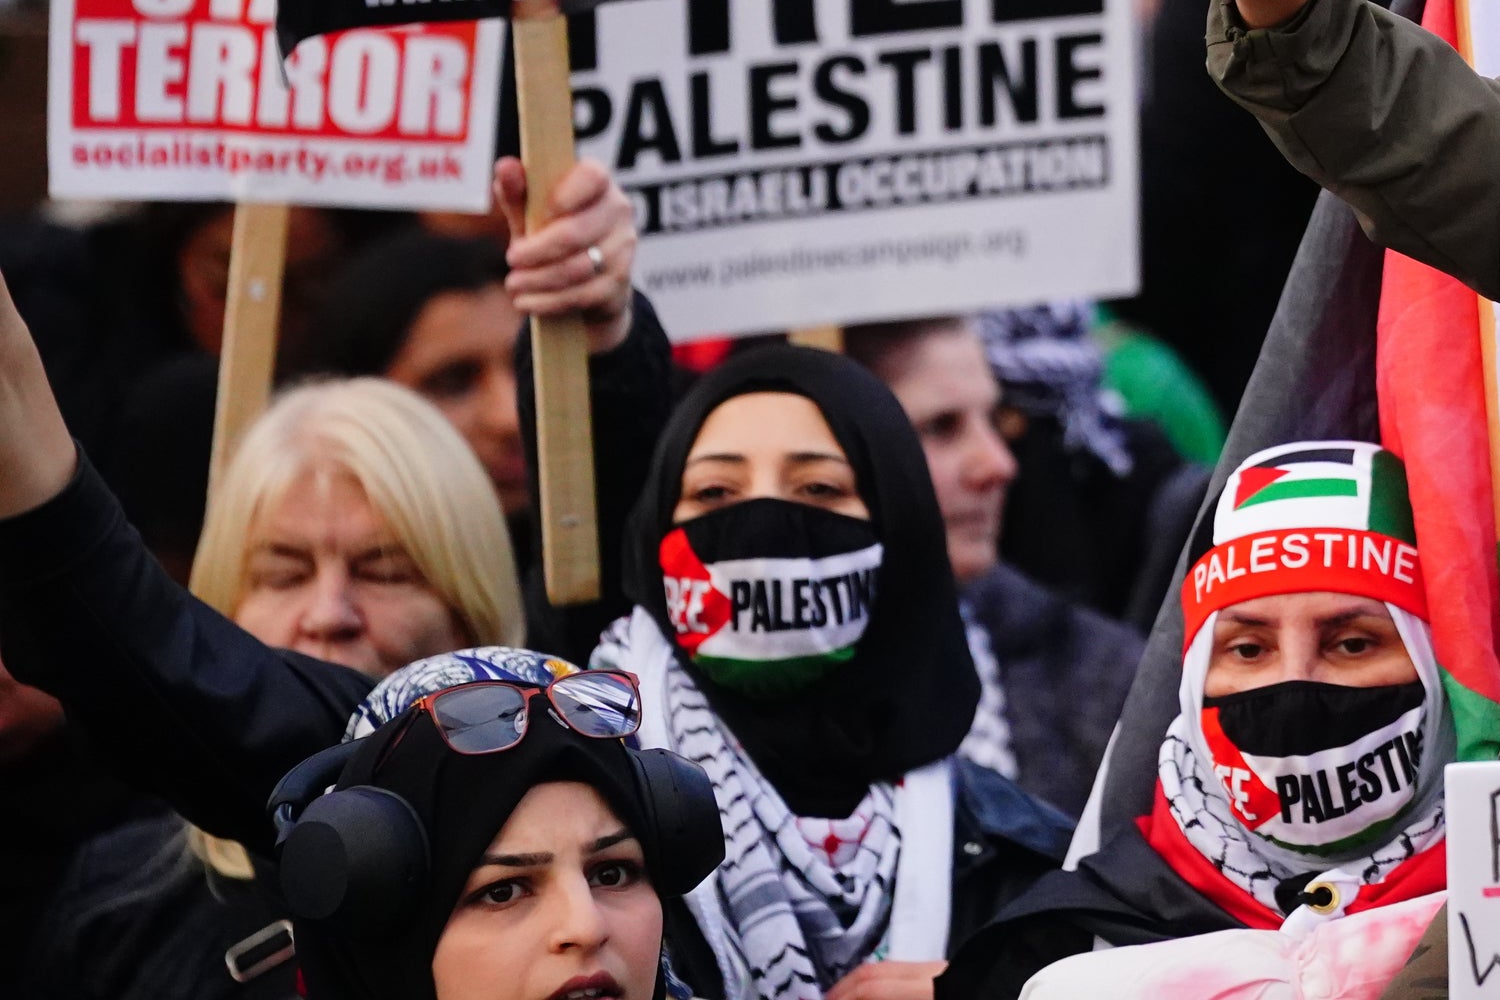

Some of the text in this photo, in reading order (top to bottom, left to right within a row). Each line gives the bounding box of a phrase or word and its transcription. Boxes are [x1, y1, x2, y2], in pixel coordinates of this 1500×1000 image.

[76, 20, 468, 136] TERROR
[573, 34, 1105, 170] PALESTINE
[71, 139, 462, 183] socialistparty.org.uk
[660, 167, 830, 229] ISRAELI
[835, 140, 1104, 204] OCCUPATION
[1193, 533, 1419, 603] PALESTINE
